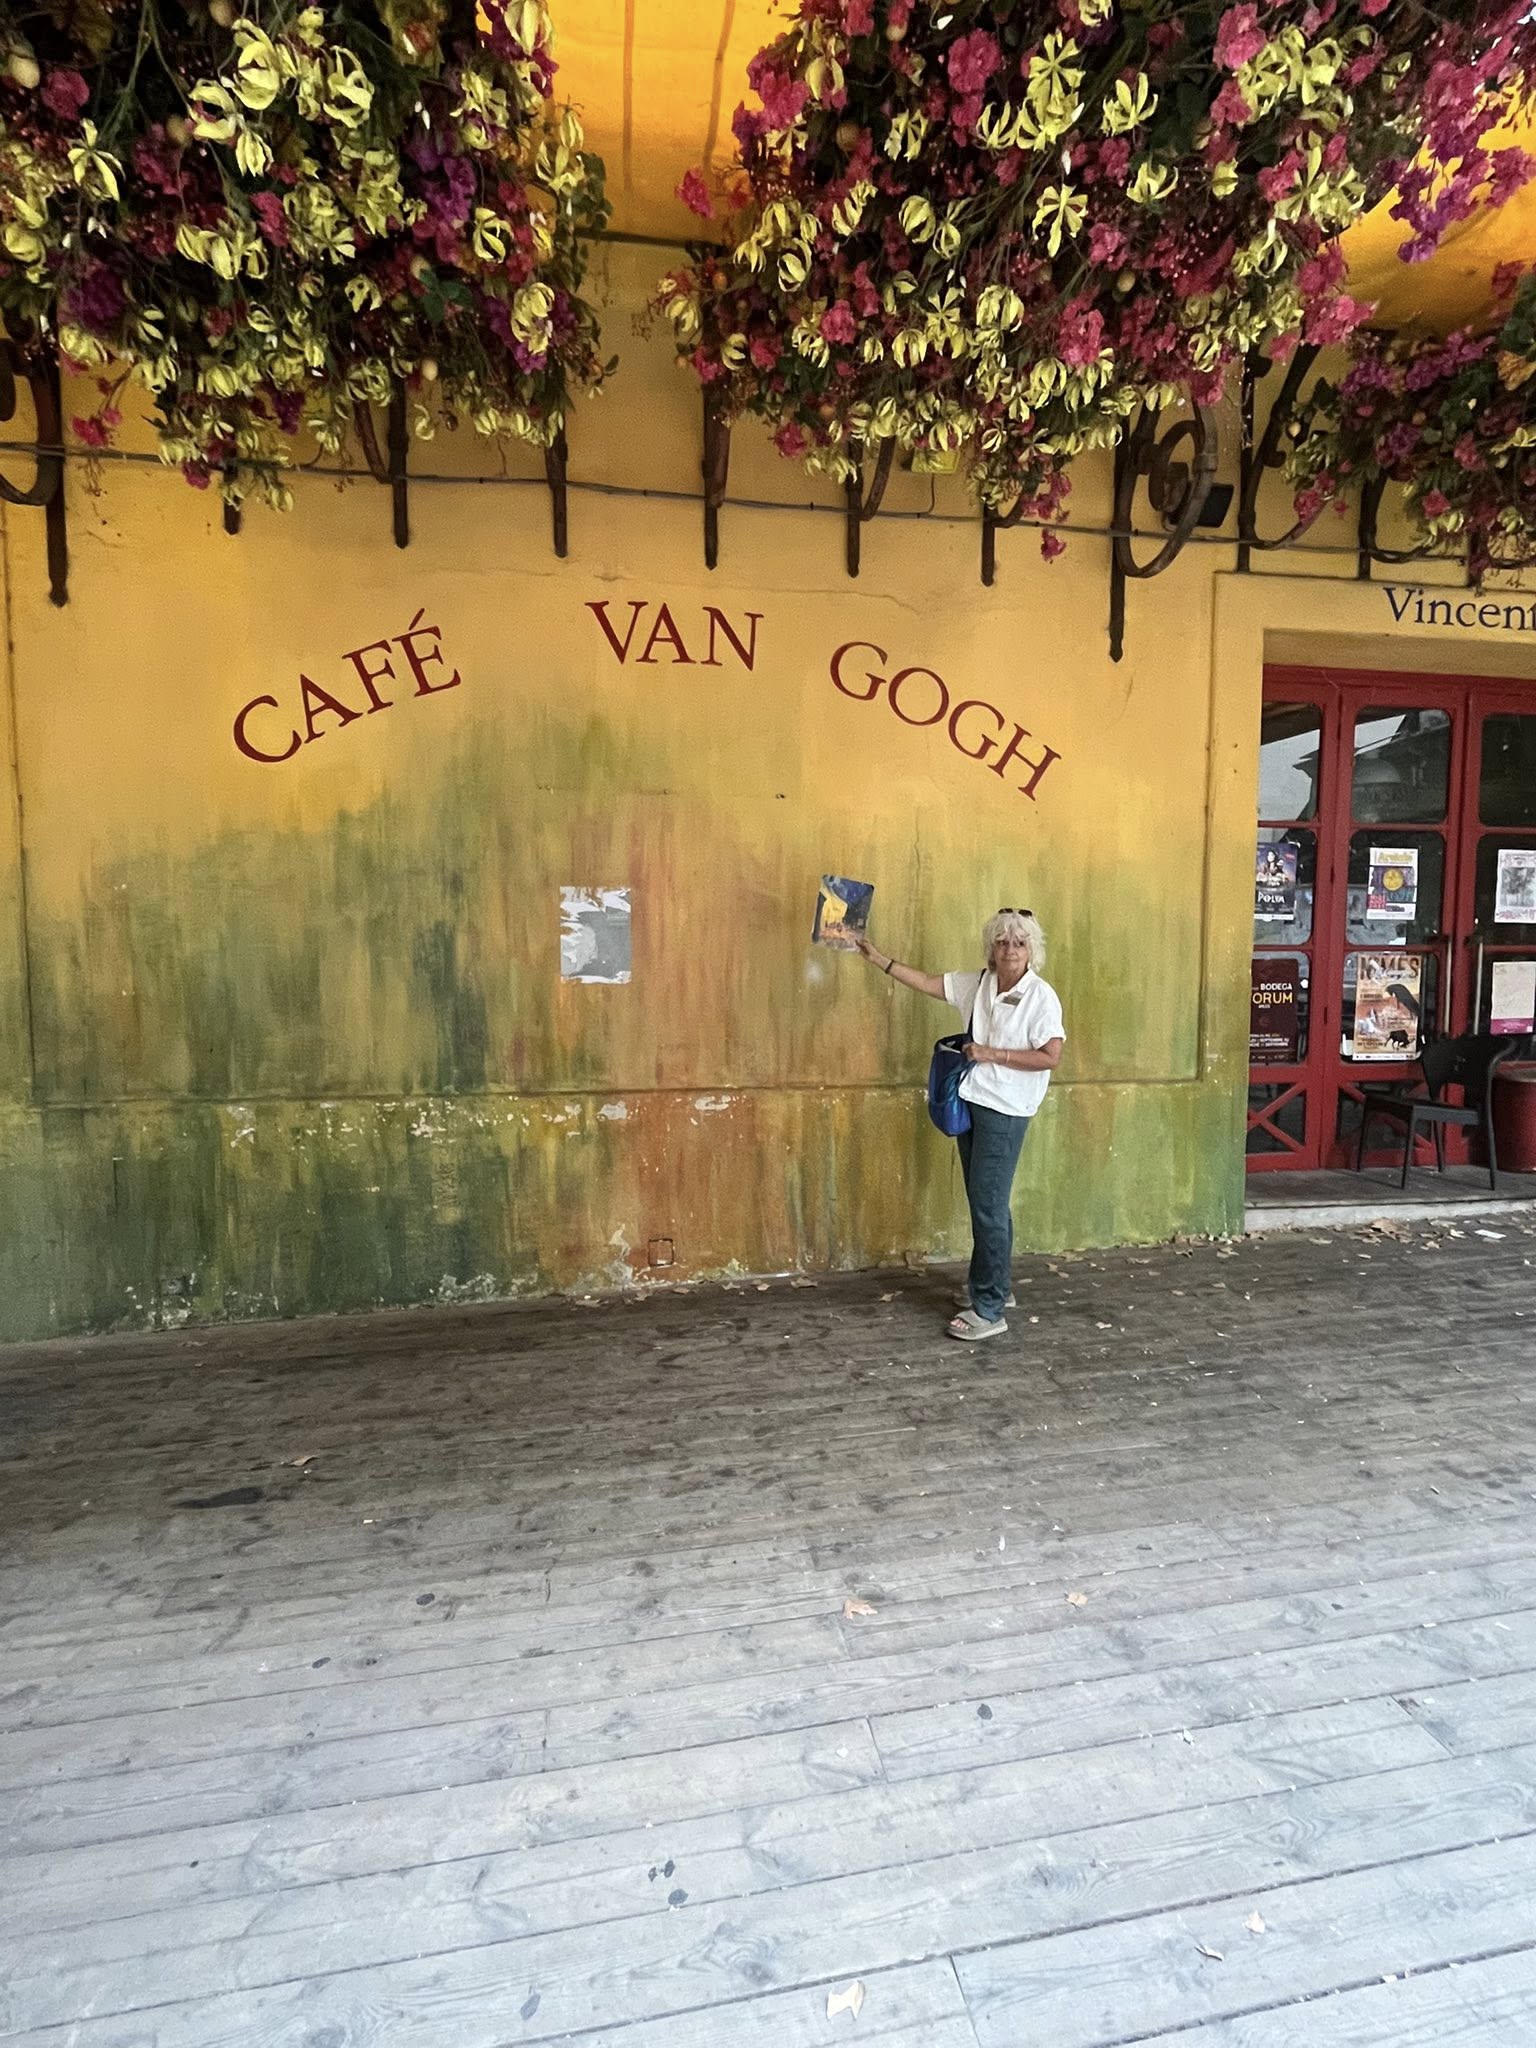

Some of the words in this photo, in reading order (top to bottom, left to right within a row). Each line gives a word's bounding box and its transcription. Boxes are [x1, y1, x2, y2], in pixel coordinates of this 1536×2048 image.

[234, 608, 461, 764] CAFÉ
[585, 600, 765, 672] VAN
[831, 642, 1062, 801] GOGH
[1360, 957, 1419, 980] NMES
[1252, 992, 1293, 1004] ORUM
